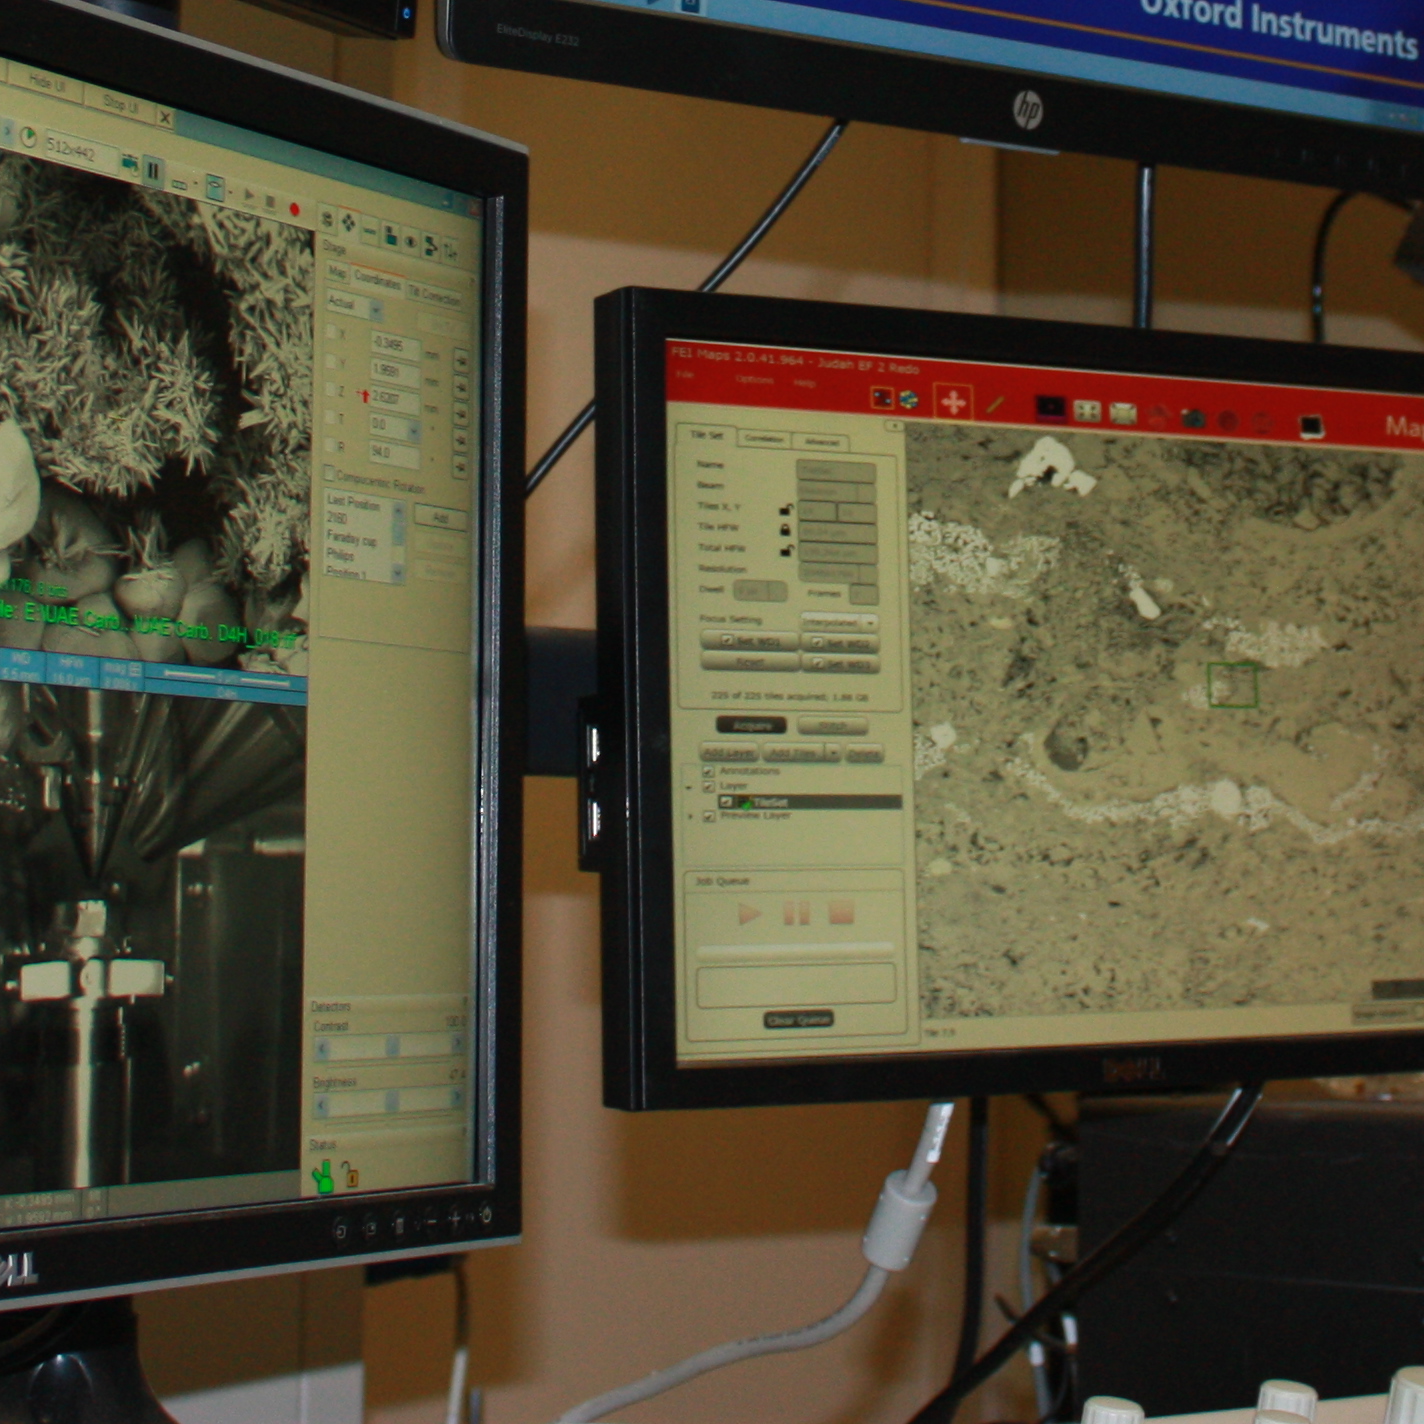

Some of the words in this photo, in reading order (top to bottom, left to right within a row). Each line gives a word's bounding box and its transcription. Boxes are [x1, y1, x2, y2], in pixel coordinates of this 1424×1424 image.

[496, 23, 553, 44] EliteDisplay
[1251, 3, 1419, 60] Instruments
[29, 73, 52, 90] Hide
[103, 94, 125, 113] Stop
[46, 137, 96, 163] 512x442
[329, 294, 355, 310] Actual
[671, 346, 693, 360] FEI
[696, 348, 730, 363] Maps
[818, 357, 855, 371] Judah
[858, 360, 873, 372] EF
[877, 361, 886, 373] 2
[889, 362, 921, 375] Redo
[736, 374, 775, 386] Options
[794, 378, 817, 389] Help
[691, 429, 707, 440] Tile
[709, 430, 724, 440] Set
[697, 459, 724, 470] Name
[697, 480, 724, 490] Beam
[327, 494, 346, 507] Last
[347, 496, 380, 512] Position
[698, 501, 720, 511] Tiles
[433, 512, 449, 525] Add
[698, 522, 715, 532] Tile
[327, 528, 360, 548] Faraday
[698, 543, 722, 553] Total
[698, 564, 747, 574] Resolution
[808, 589, 841, 598] Frames
[700, 614, 727, 624] Focus
[730, 614, 763, 627] Setting
[764, 691, 783, 701] tiles
[704, 748, 724, 758] Add
[726, 748, 755, 760] Layer
[770, 748, 790, 758] Add
[719, 766, 781, 776] Annotations
[720, 782, 748, 792] Layer
[720, 811, 761, 820] Preview
[763, 811, 791, 822] Layer
[696, 876, 714, 886] Job
[716, 876, 750, 887] Queue
[311, 1000, 351, 1014] Detectors
[314, 1021, 349, 1032] Contrast
[313, 1077, 357, 1092] Brightness
[309, 1139, 337, 1152] Status
